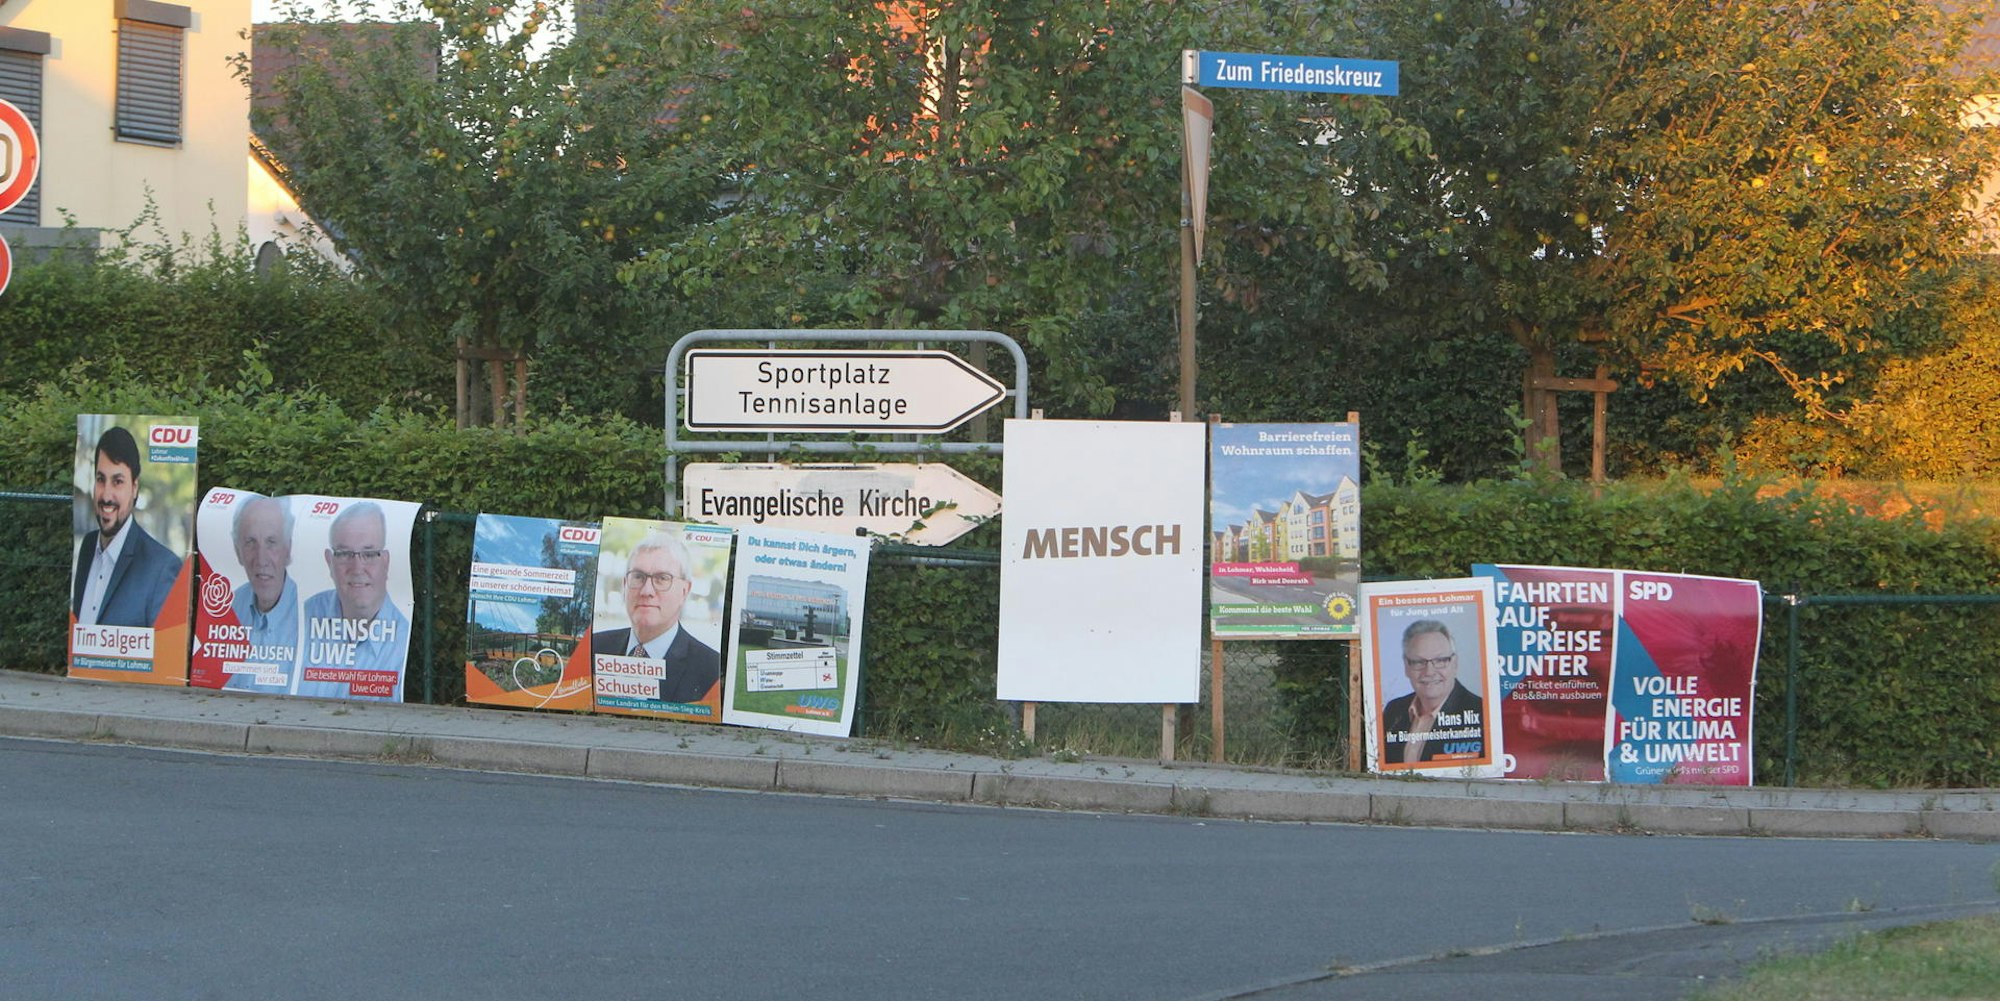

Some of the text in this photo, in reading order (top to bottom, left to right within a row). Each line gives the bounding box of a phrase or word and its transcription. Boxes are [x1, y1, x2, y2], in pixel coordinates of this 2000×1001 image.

[1216, 59, 1382, 88] Zum Friedenskreuz
[757, 362, 890, 388] Sportplatz
[738, 391, 907, 420] Tennisanlage
[151, 428, 191, 443] CDU
[1258, 431, 1351, 442] Barrierefreien
[1221, 445, 1351, 456] Wohnraum schaffen
[209, 492, 235, 504] SPD
[701, 488, 930, 524] Evangelische Kirche
[312, 502, 339, 515] SPD
[562, 529, 596, 542] CDU
[1023, 525, 1181, 559] MENSCH
[748, 536, 857, 559] Du kannst Dich ärgern,
[755, 555, 847, 572] oder etwas ändern!
[1227, 566, 1255, 574] Lohmar,
[1255, 566, 1296, 574] Wahlscheid,
[472, 565, 569, 580] Eine gesunde Sommerzeit
[480, 582, 509, 590] unserer
[510, 583, 543, 593] schönen
[543, 586, 571, 596] Heimat
[1497, 582, 1608, 603] FAHRTEN
[1629, 580, 1673, 602] SPD
[1378, 594, 1475, 606] Ein besseres Lohmar
[1219, 605, 1313, 614] Kommunal die beste Wahl
[1390, 605, 1464, 617] für Jung und Alt
[208, 624, 253, 641] HORST
[310, 617, 396, 642] MENSCH
[76, 627, 150, 654] Tim Salgert
[1522, 630, 1601, 652] PREISE
[203, 643, 294, 662] STEINHAUSEN
[310, 642, 357, 666] UWE
[766, 652, 804, 660] Stimmzettel
[117, 659, 126, 667] für
[224, 663, 278, 674] Zusammen sind
[597, 658, 663, 676] Sebastian
[256, 675, 286, 684] wir stark
[306, 669, 397, 683] Die beste Wahl für Lohmar:
[352, 684, 390, 694] Uwe Grote
[597, 678, 657, 696] Schuster
[1554, 681, 1599, 690] einführen,
[1633, 676, 1698, 696] VOLLE
[799, 695, 840, 711] UWG
[1512, 690, 1602, 700] Bus&Bahn ausbauen
[598, 698, 615, 706] Unser
[616, 699, 640, 708] Landrat
[640, 700, 650, 708] für
[662, 703, 711, 715] Rhein-Sieg-Kreis
[1652, 698, 1742, 718] ENERGIE
[1437, 709, 1480, 726] Hans Nix
[1386, 727, 1482, 743] Ihr Bürgermeisterkandidat
[1620, 716, 1736, 741] FÜR KLIMA
[1443, 741, 1482, 754] UWG
[1620, 742, 1741, 764] & UMWELT
[1635, 767, 1663, 775] Grüner
[1722, 765, 1740, 774] SPD
